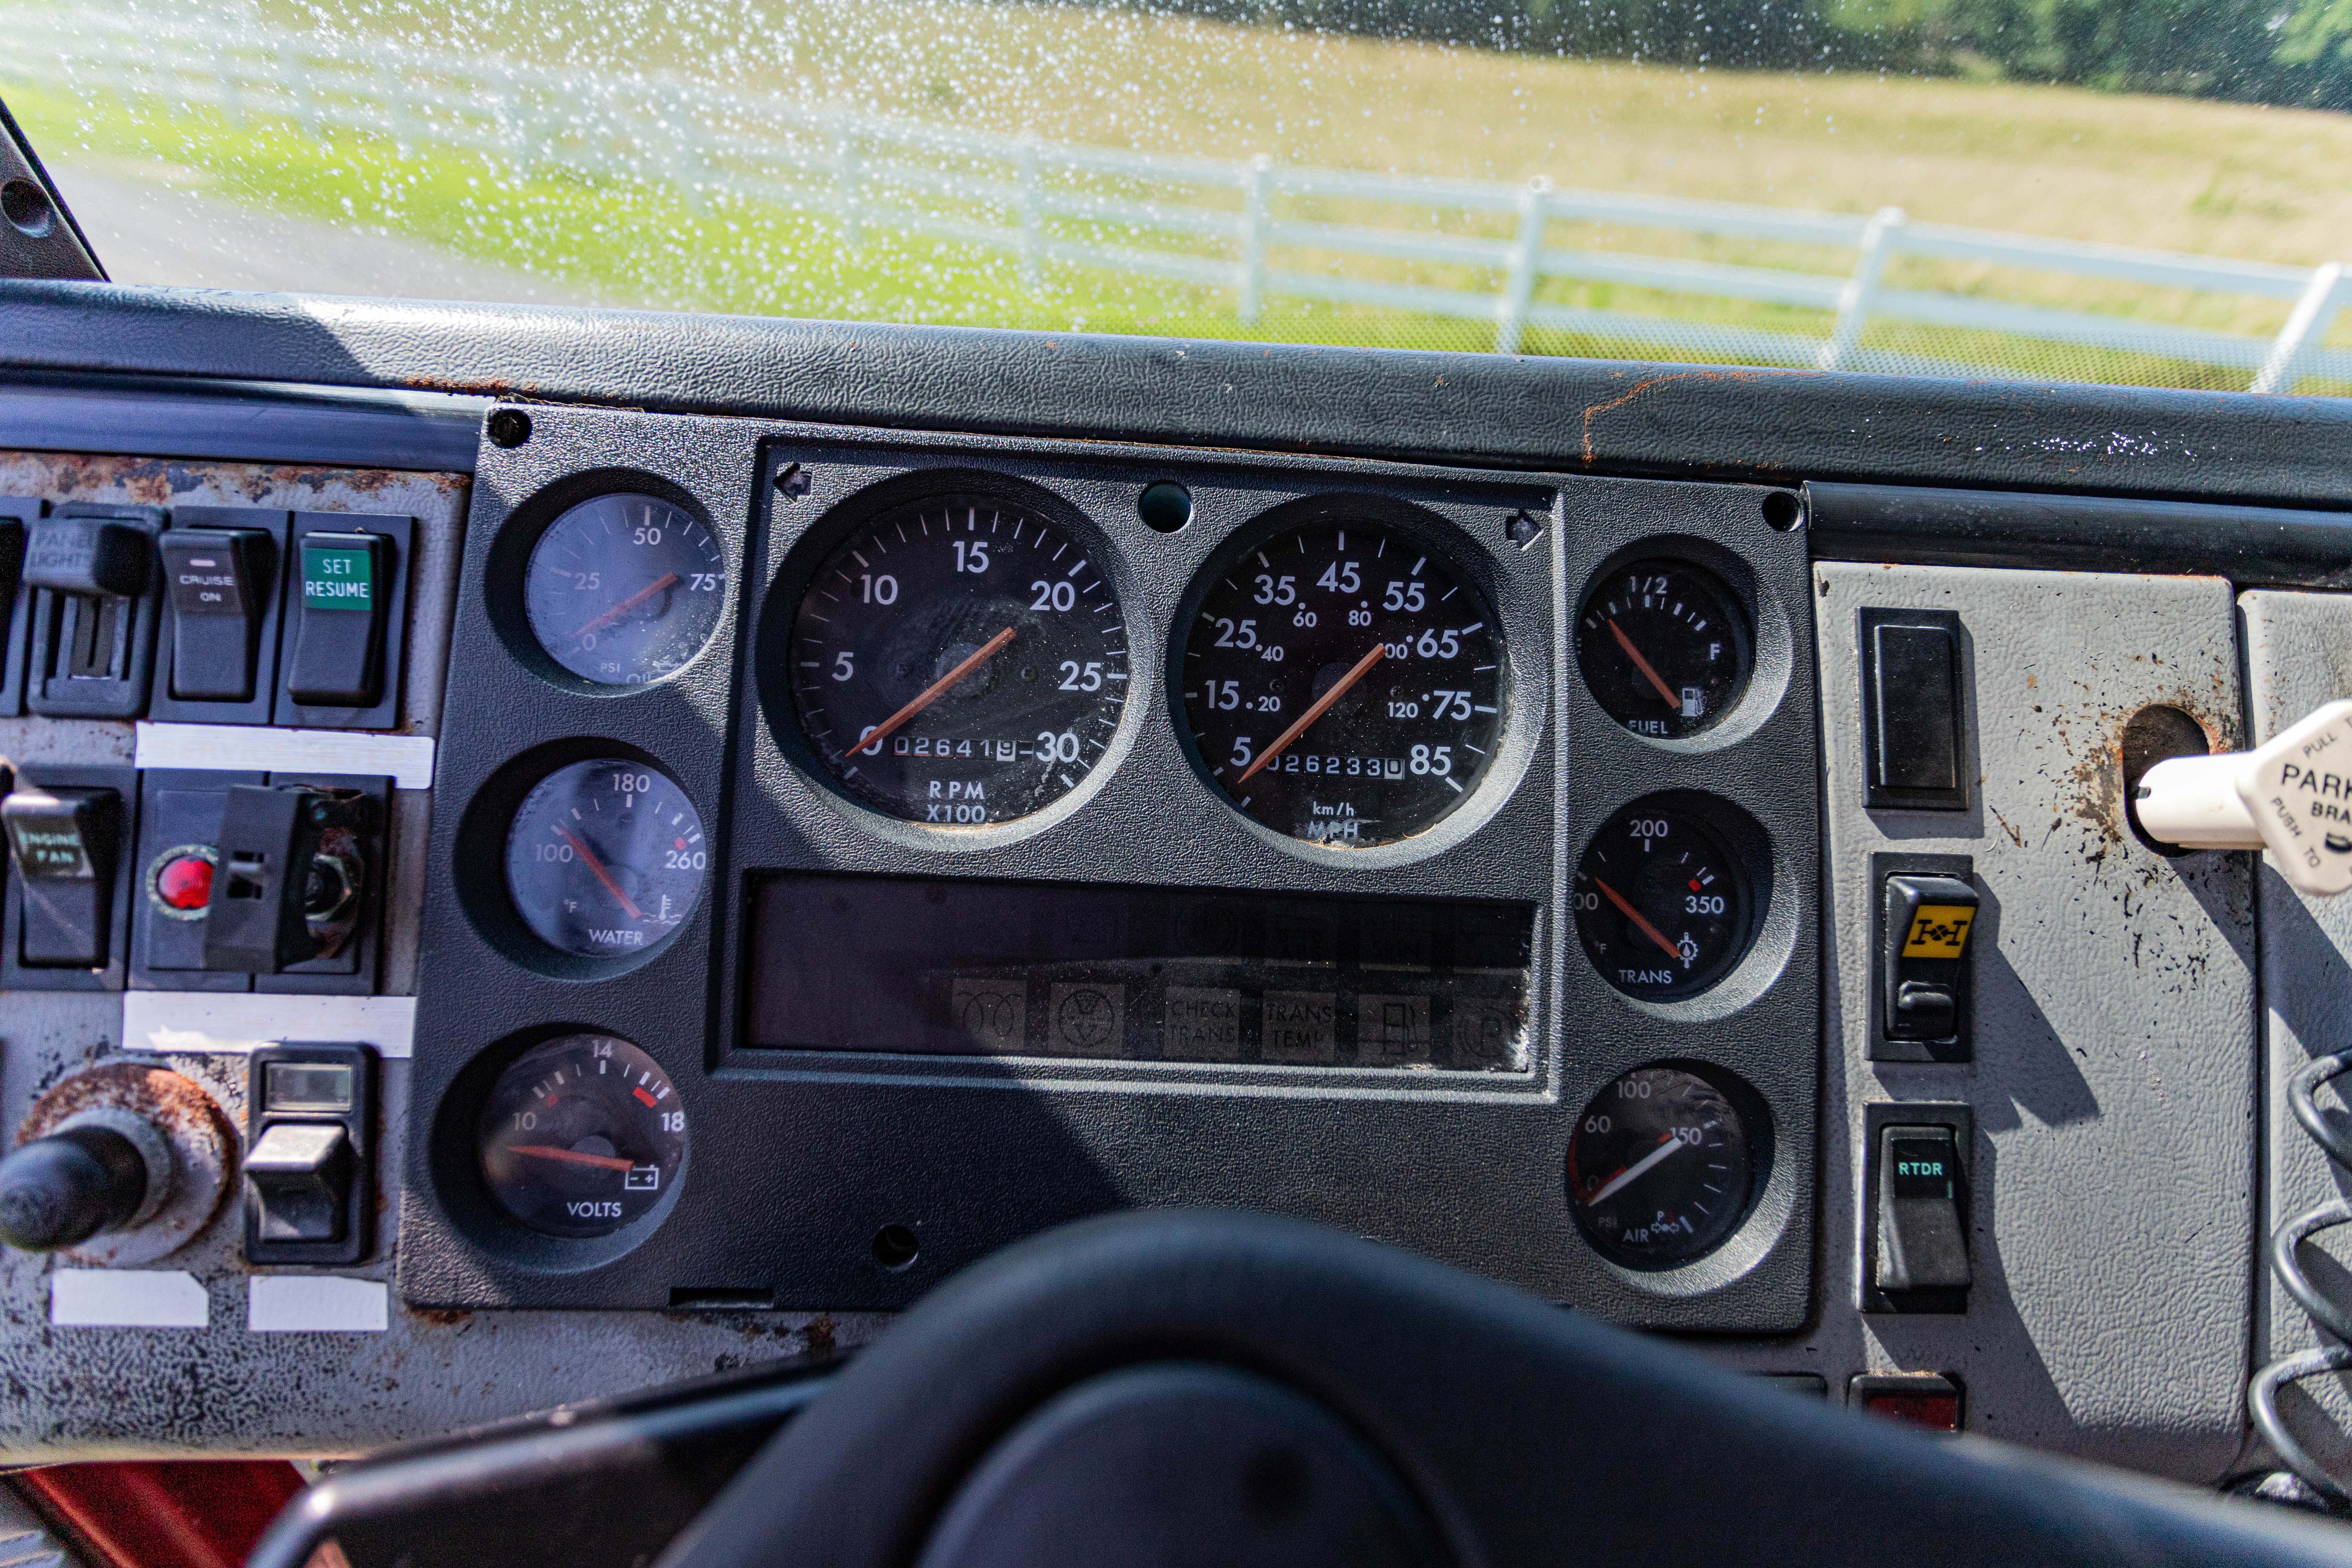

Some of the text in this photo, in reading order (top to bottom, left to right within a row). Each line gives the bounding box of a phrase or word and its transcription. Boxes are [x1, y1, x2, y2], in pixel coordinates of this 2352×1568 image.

[632, 528, 661, 545] 50
[952, 541, 989, 573] 15
[323, 559, 351, 574] SET
[179, 575, 234, 586] CRUISE
[574, 572, 600, 590] 25
[690, 573, 717, 591] 75
[1316, 562, 1361, 593] 45
[1629, 576, 1668, 594] 1/2
[200, 592, 222, 602] ON
[305, 581, 369, 598] RESUME
[859, 575, 899, 605] 10
[1029, 580, 1076, 612] 20
[1253, 574, 1296, 606] 35
[1383, 581, 1426, 612] 55
[1293, 611, 1317, 627] 60
[1348, 610, 1371, 626] 80
[582, 633, 597, 651] 0
[1214, 618, 1257, 649] 25
[1378, 643, 1408, 659] 00
[1416, 629, 1459, 658] 65
[1710, 643, 1721, 660] F
[1261, 646, 1284, 662] 40
[600, 662, 620, 674] PSI
[831, 651, 854, 681] 5
[1058, 661, 1102, 692] 25
[1205, 680, 1239, 711] 15
[1258, 696, 1280, 712] 20
[1388, 702, 1418, 718] 120
[1432, 691, 1472, 720] 75
[1628, 720, 1668, 735] FUEL
[859, 726, 883, 756] 0
[894, 736, 1015, 757] 026419
[1036, 732, 1080, 763] 30
[2302, 733, 2337, 758] PULL
[1230, 737, 1251, 766] 5
[1410, 744, 1451, 776] 85
[1266, 754, 1401, 776] 0262330
[613, 773, 650, 793] 180
[929, 781, 984, 799] RPM
[926, 804, 985, 823] X100
[1313, 801, 1354, 816] km/h
[2271, 797, 2301, 837] PUSH
[1307, 820, 1358, 839] MPH
[1629, 819, 1668, 838] 200
[18, 831, 81, 847] ENGINE
[36, 850, 74, 863] FAN
[536, 844, 574, 863] 100
[665, 850, 706, 870] 260
[2305, 847, 2321, 868] TO
[1574, 893, 1599, 911] 00
[1685, 895, 1725, 914] 350
[588, 929, 643, 945] WATER
[1618, 969, 1672, 984] TRANS
[1171, 1000, 1238, 1018] CHECK
[1268, 1003, 1332, 1023] TRANS
[1169, 1025, 1236, 1043] TRANS
[592, 1040, 613, 1058] 14
[1617, 1081, 1651, 1099] 100
[513, 1112, 537, 1131] 10
[662, 1112, 686, 1132] 18
[1585, 1115, 1611, 1134] 60
[1670, 1127, 1703, 1145] 150
[1899, 1162, 1943, 1176] RTDR
[567, 1202, 622, 1217] VOLTS
[1623, 1228, 1649, 1243] AIR
